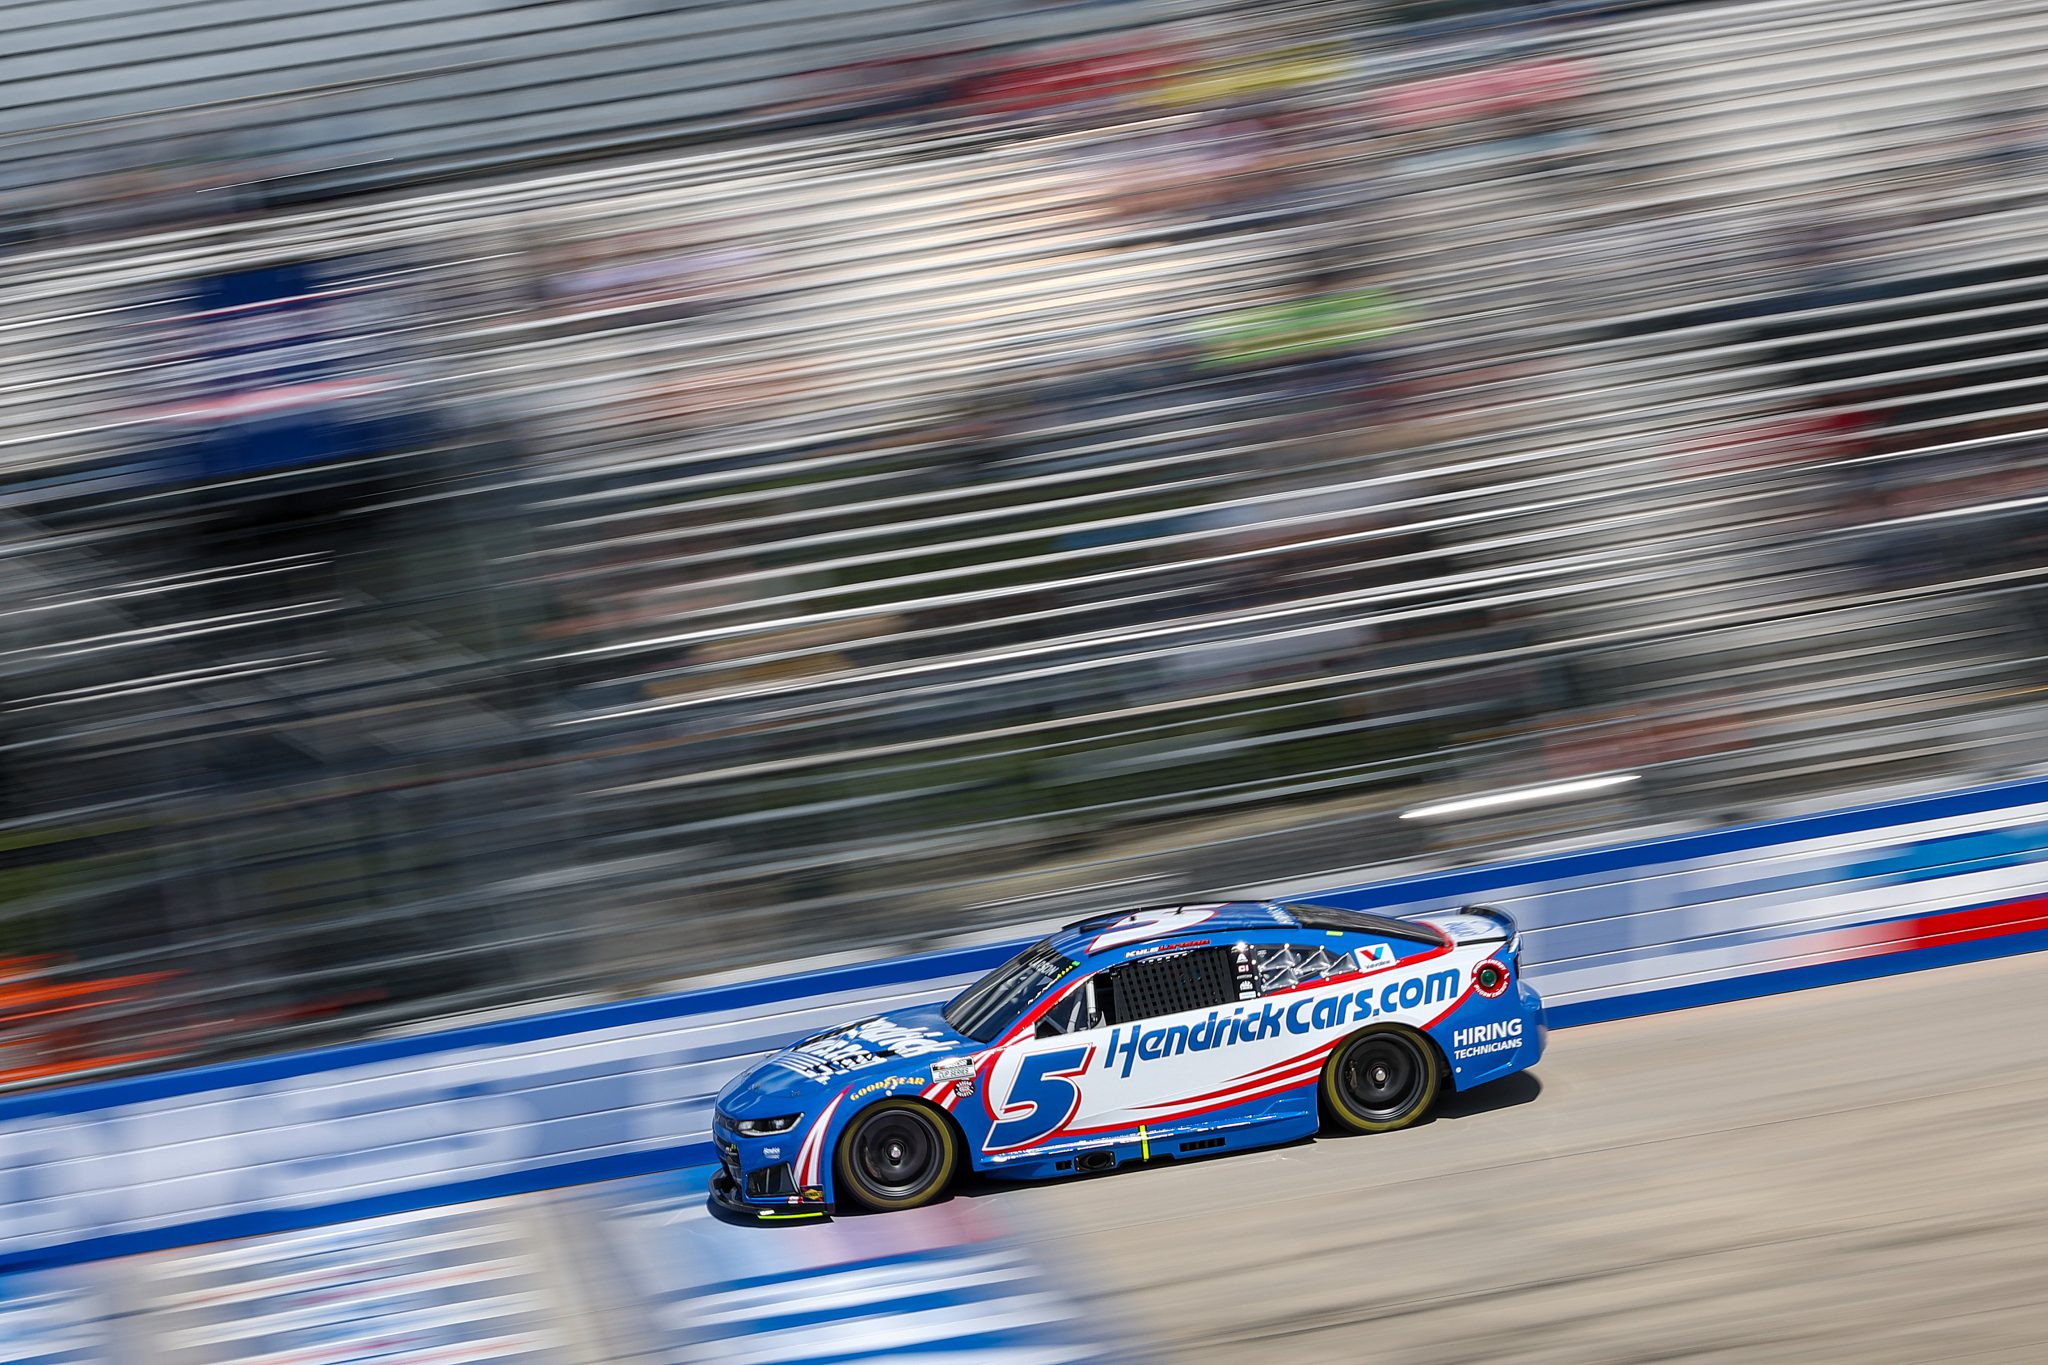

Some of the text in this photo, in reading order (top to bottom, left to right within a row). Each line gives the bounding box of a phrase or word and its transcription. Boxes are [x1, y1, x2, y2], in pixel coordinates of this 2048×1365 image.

[1104, 968, 1461, 1078] HendrickCars.com
[1454, 1018, 1523, 1048] HIRING
[1454, 1038, 1523, 1060] TECHNICIANS
[850, 1075, 925, 1100] GOODYEAR
[983, 1042, 1097, 1155] 5
